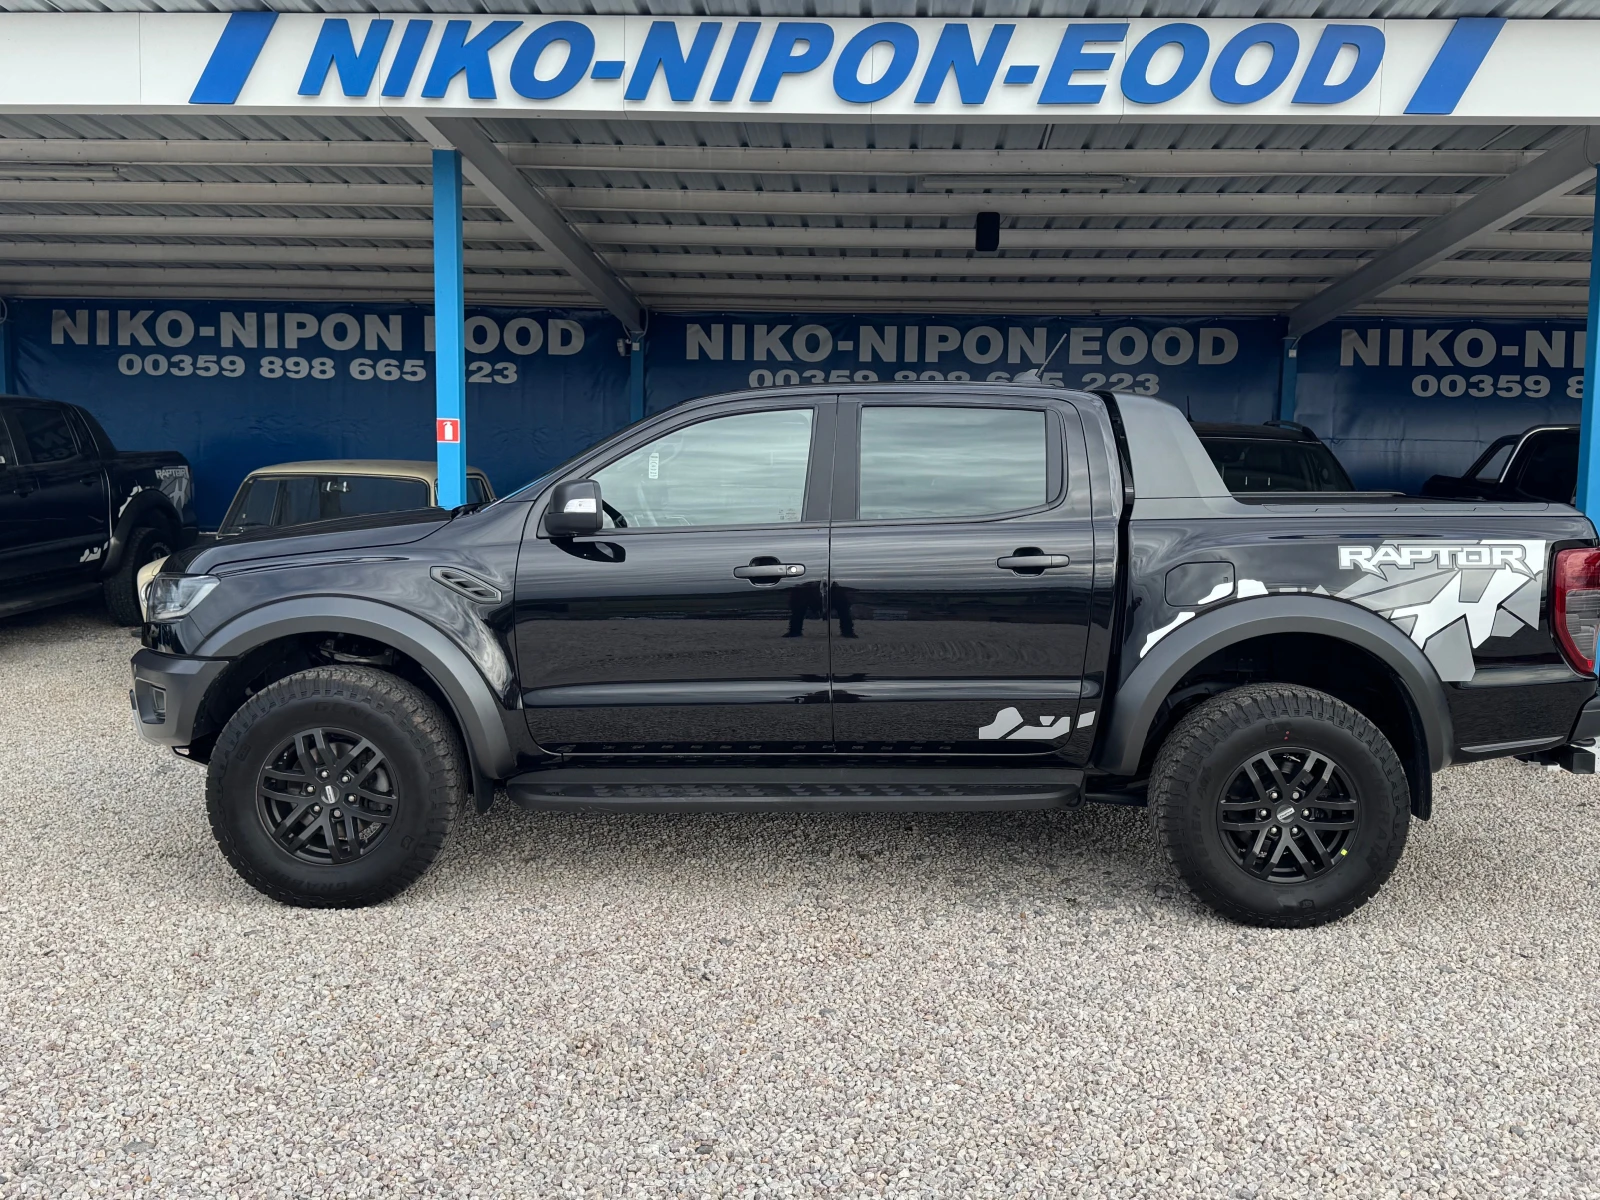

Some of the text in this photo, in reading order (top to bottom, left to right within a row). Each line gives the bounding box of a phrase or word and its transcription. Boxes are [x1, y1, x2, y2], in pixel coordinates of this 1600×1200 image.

[298, 19, 1385, 104] NIKO-NIPON-EOOD
[51, 309, 402, 352] NIKO-NIPON
[686, 323, 1239, 366] NIKO-NIPON EOOD
[118, 353, 518, 384] 00359 898 665 23
[1411, 374, 1551, 398] 00359
[155, 469, 186, 480] RAPTOR
[1338, 544, 1537, 581] RAPTOR
